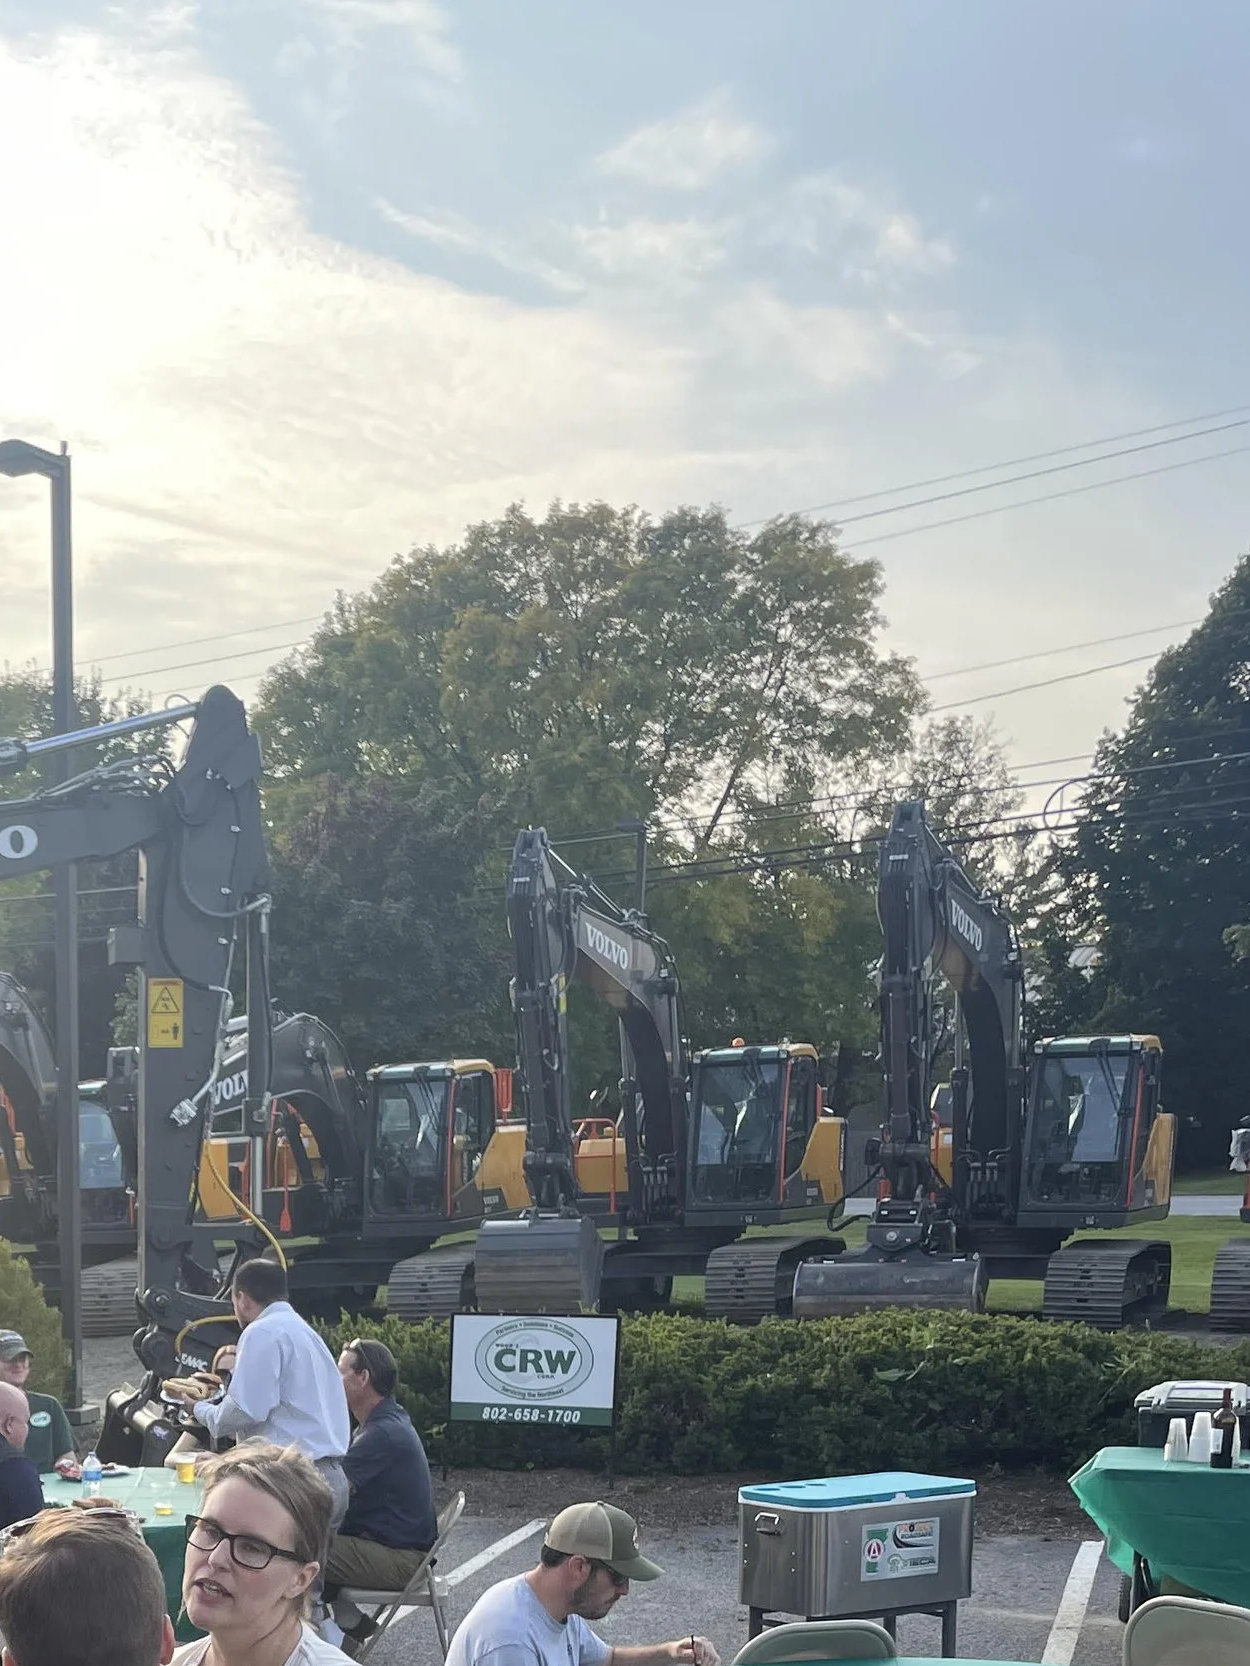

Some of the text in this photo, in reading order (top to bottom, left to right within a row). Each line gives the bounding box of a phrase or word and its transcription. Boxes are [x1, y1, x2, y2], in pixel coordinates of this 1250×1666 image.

[951, 899, 982, 952] VOLVO
[585, 922, 628, 969] VOLVO
[494, 1348, 576, 1374] CRW
[482, 1406, 581, 1424] 802-658-1700
